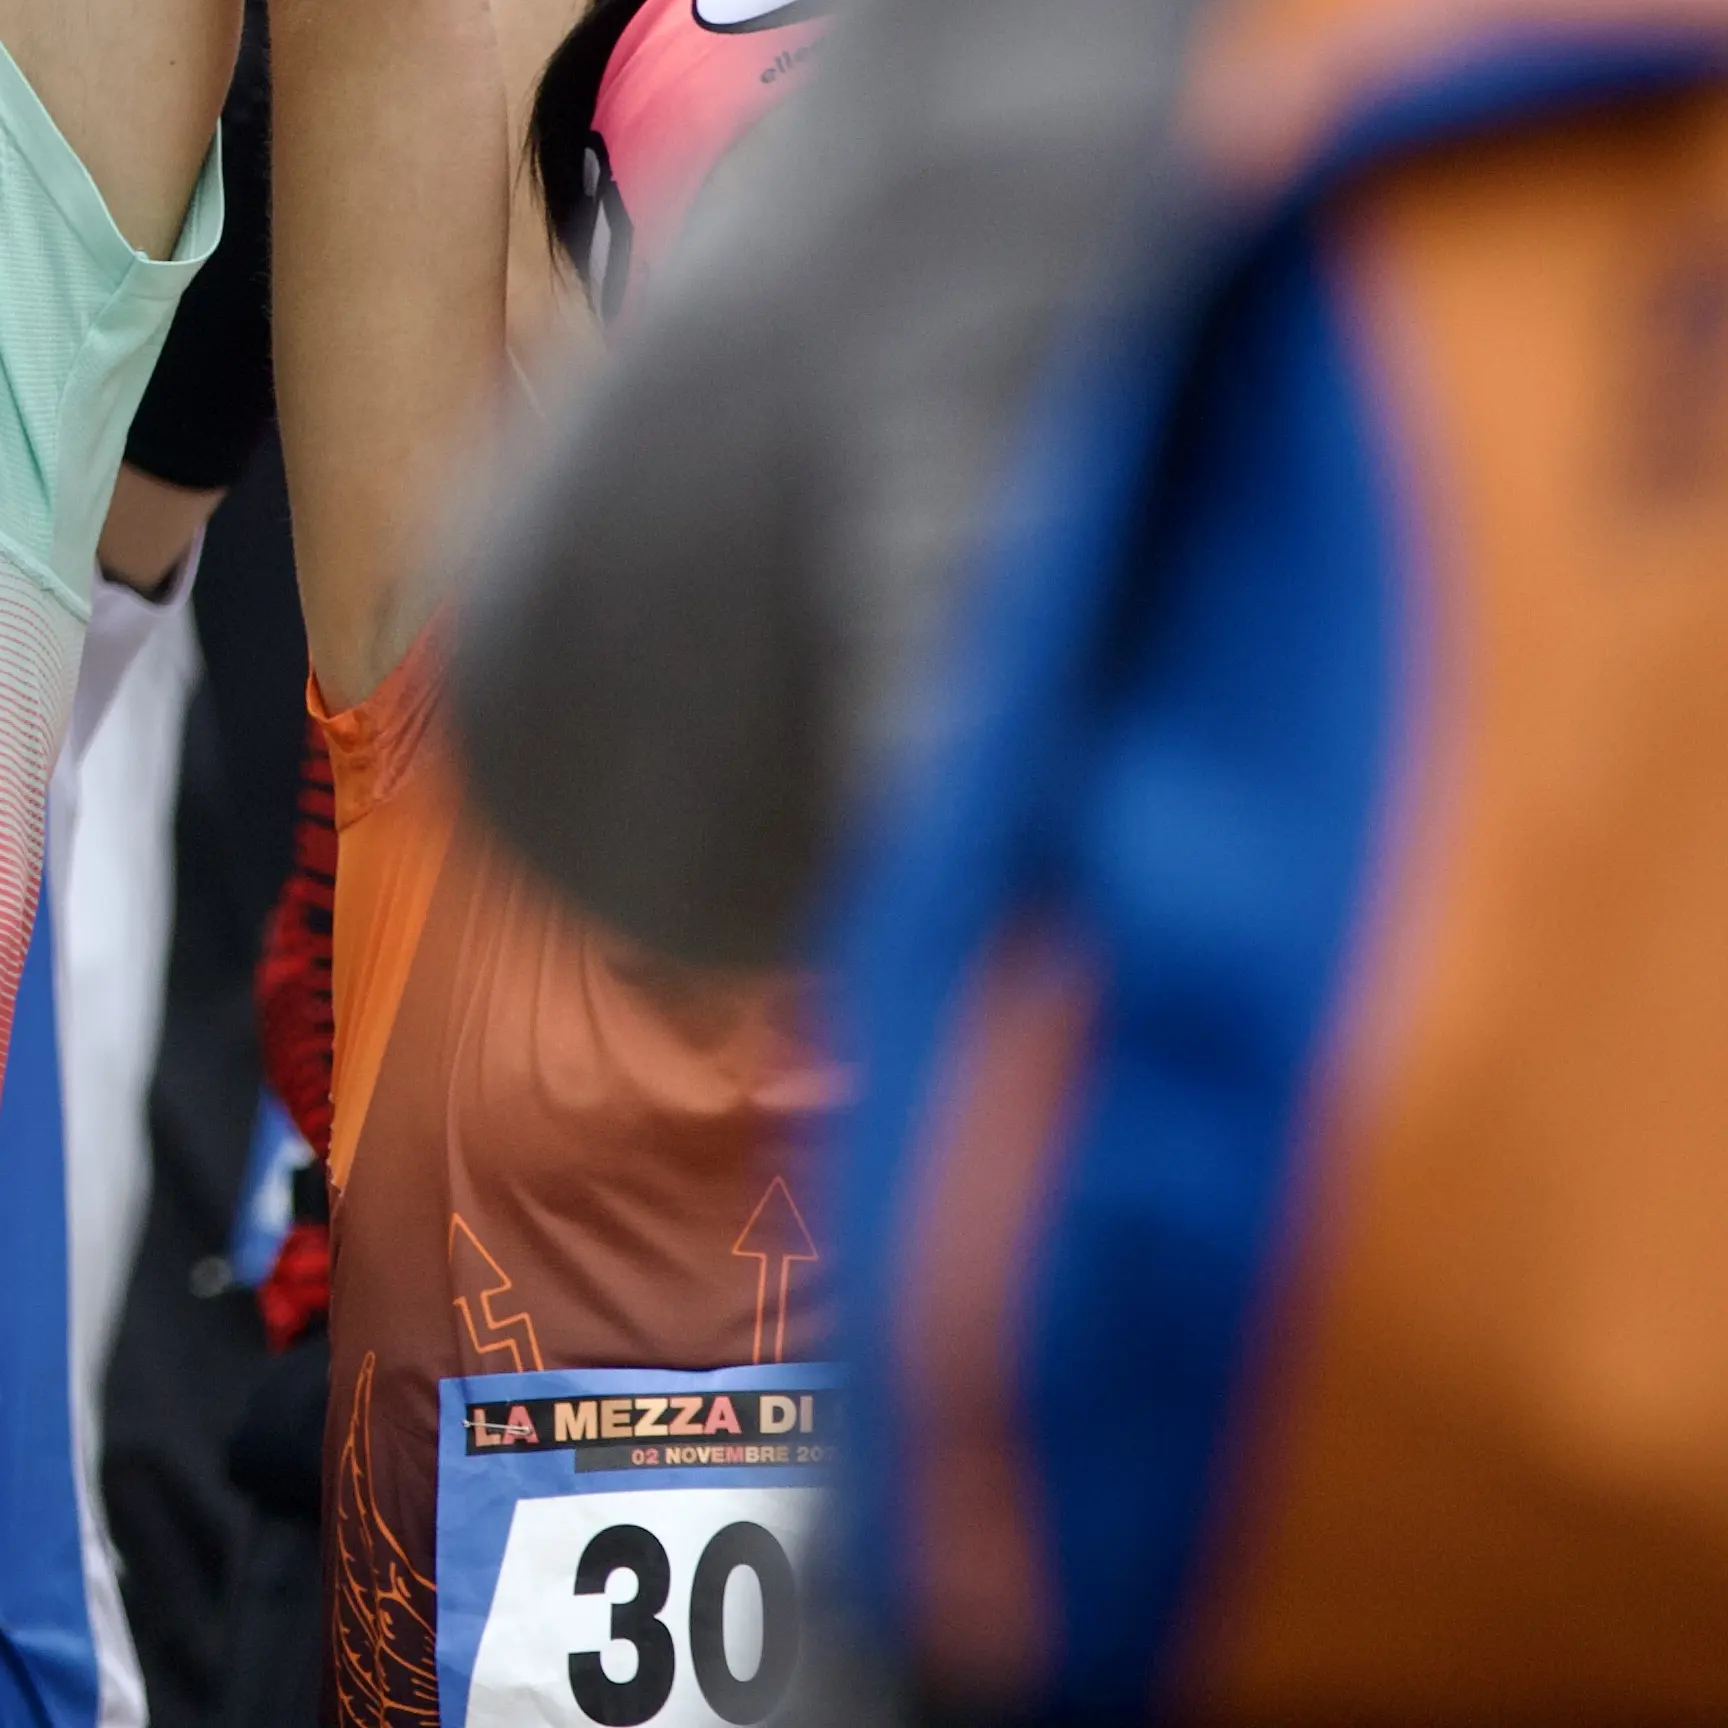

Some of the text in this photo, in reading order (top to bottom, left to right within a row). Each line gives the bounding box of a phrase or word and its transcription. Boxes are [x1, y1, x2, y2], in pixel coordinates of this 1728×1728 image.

[472, 1394, 814, 1448] LA MEZZA DI
[630, 1444, 838, 1466] 02 NOVEMBRE 20
